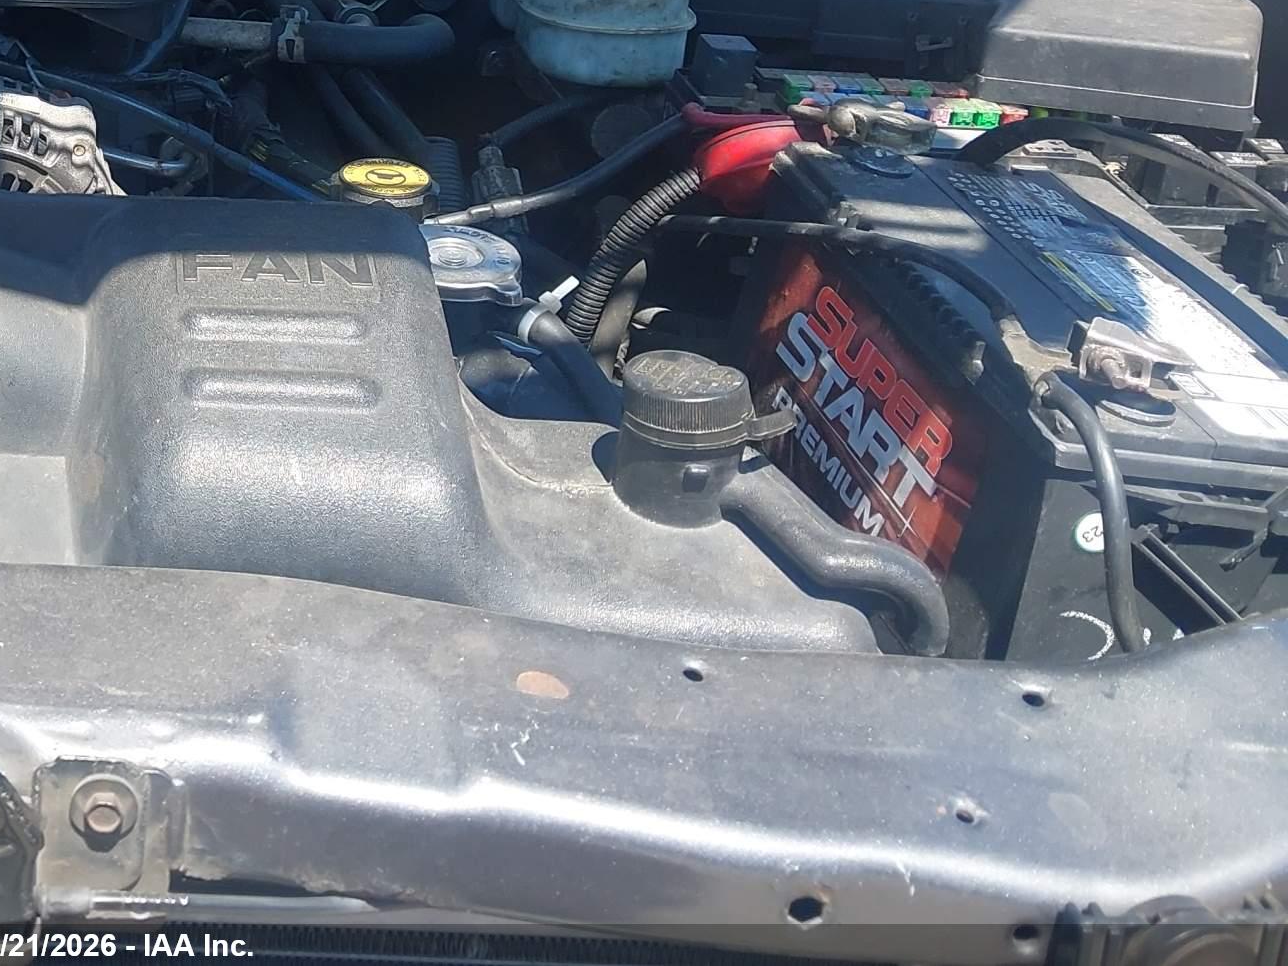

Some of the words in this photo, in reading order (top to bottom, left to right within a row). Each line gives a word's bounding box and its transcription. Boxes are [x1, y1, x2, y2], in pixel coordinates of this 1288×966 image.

[180, 250, 377, 288] FAN
[771, 386, 887, 536] PREMIUM
[776, 312, 937, 509] START
[808, 286, 953, 476] SUPER
